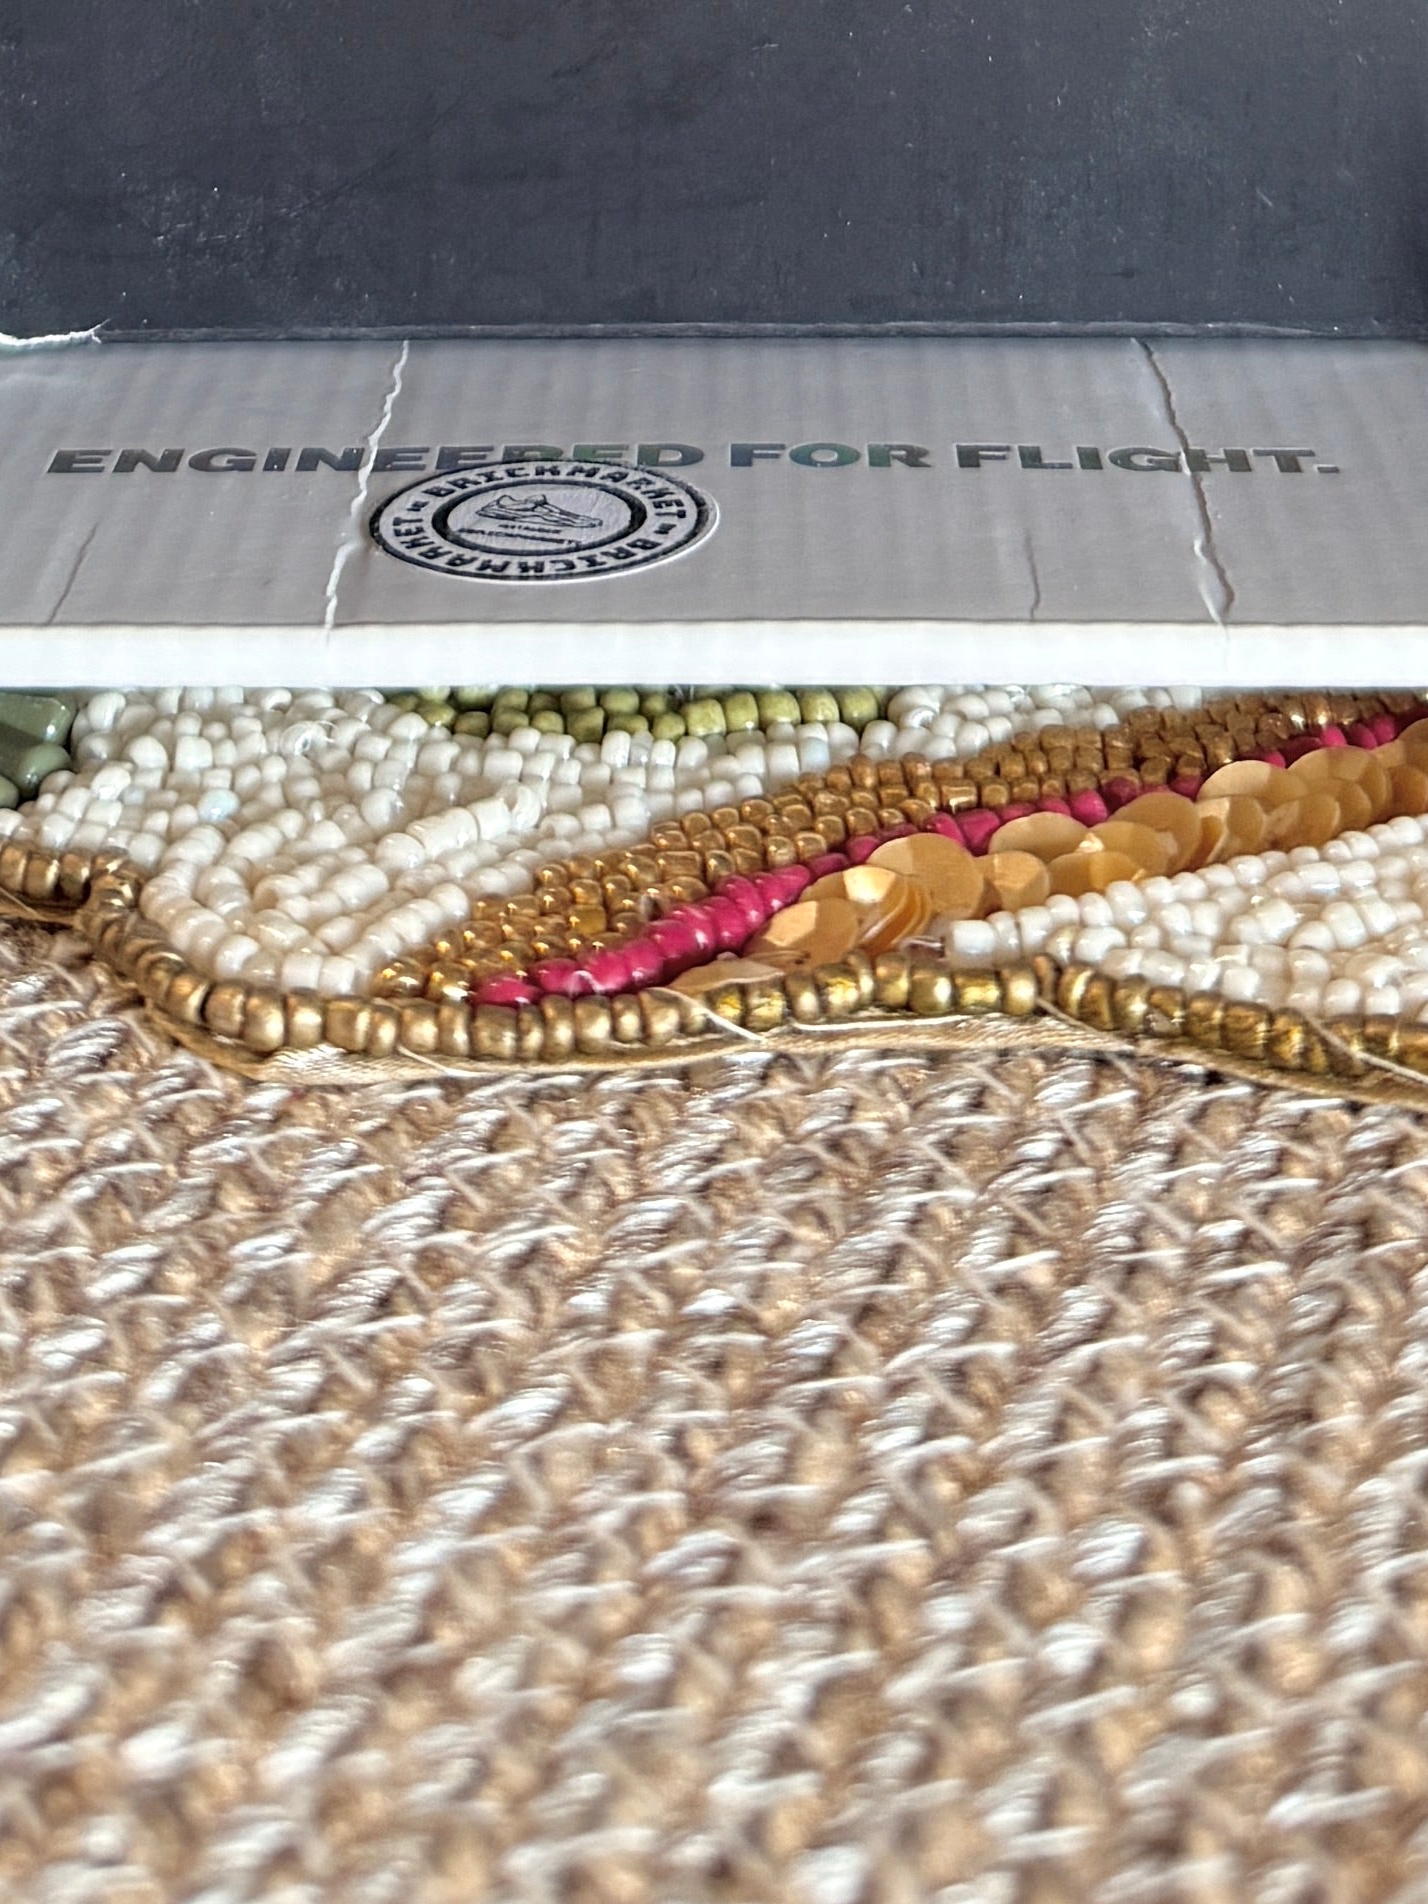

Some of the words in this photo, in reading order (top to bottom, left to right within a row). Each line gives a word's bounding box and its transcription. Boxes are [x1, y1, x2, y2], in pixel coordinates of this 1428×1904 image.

[47, 443, 706, 474] ENGINEERED
[730, 442, 933, 468] FOR
[954, 442, 1341, 474] FLIGHT.
[422, 464, 687, 520] BRICKMARKET
